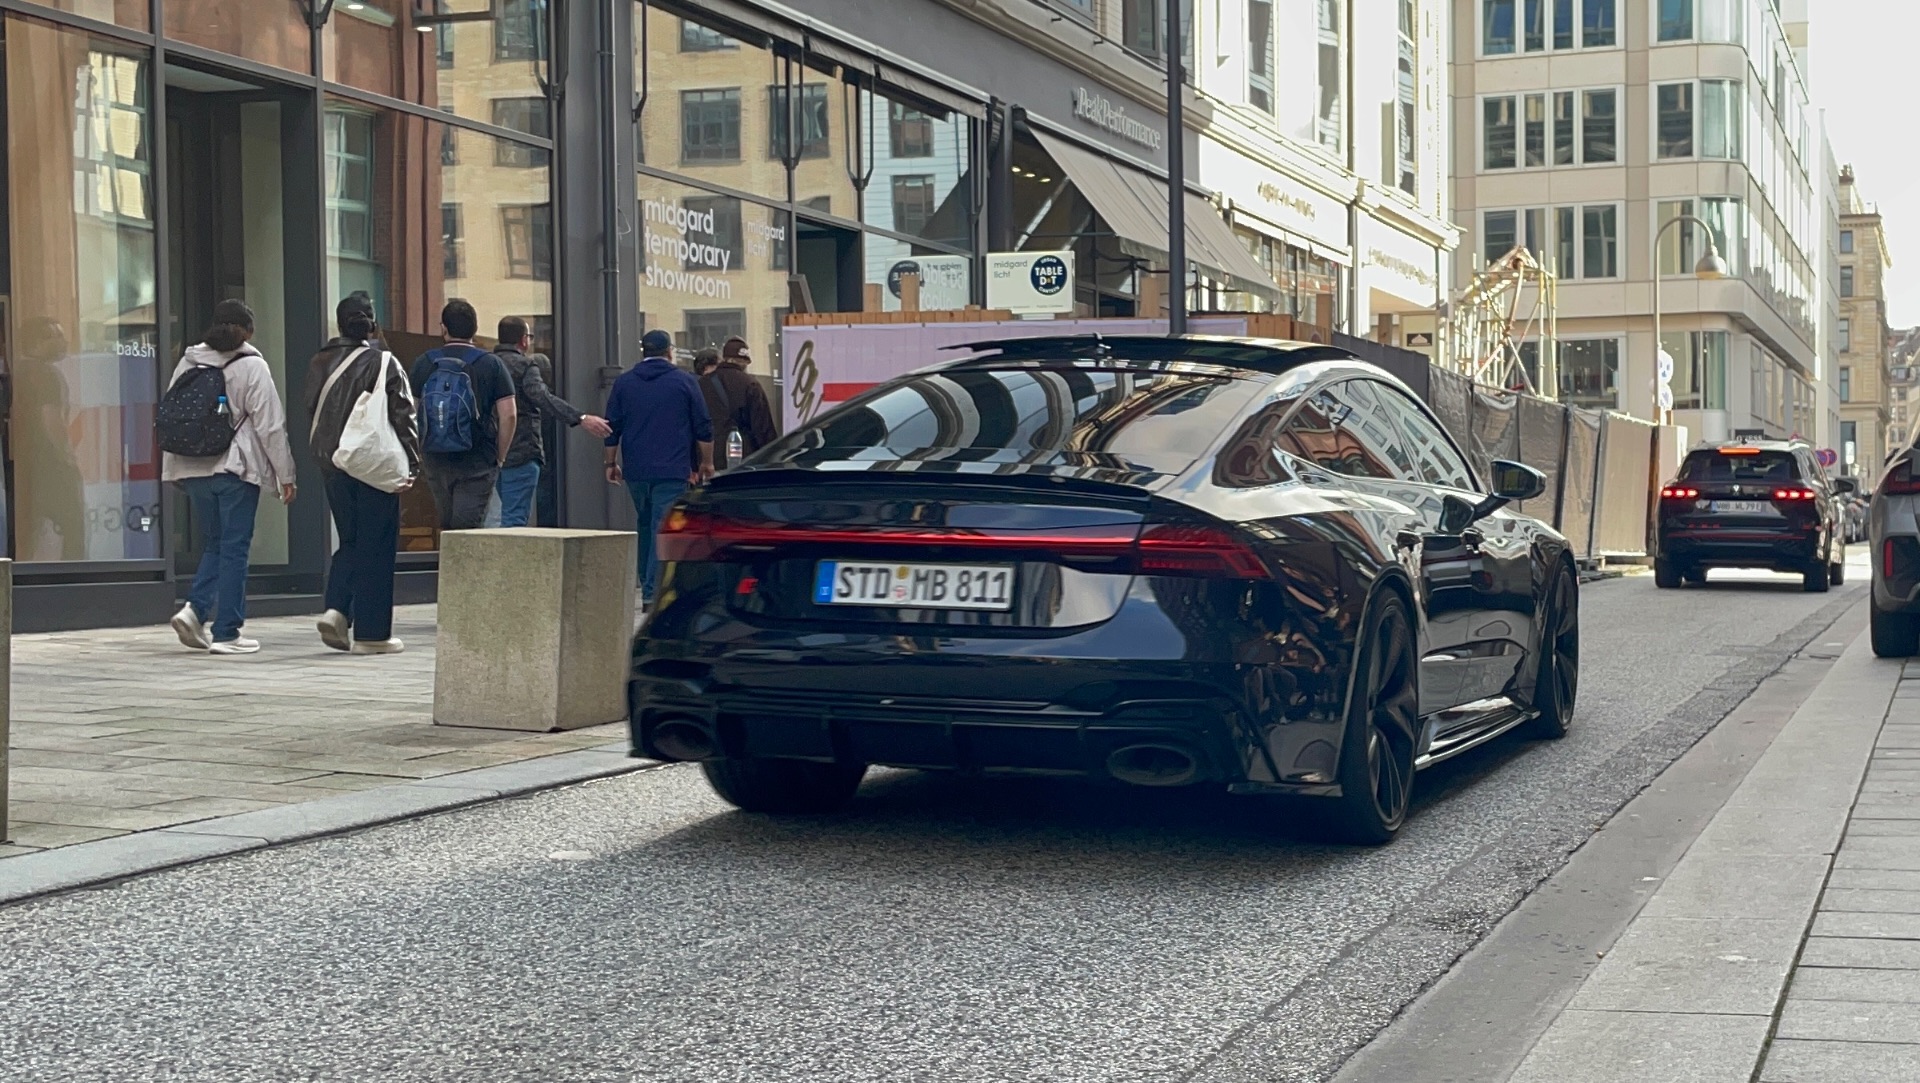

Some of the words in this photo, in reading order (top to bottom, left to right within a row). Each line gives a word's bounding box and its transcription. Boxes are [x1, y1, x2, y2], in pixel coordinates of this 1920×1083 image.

[644, 197, 714, 235] midgard
[747, 220, 785, 242] midgard
[644, 227, 731, 274] temporary
[993, 260, 1028, 270] midgard
[993, 271, 1011, 279] licht
[1034, 266, 1063, 276] TABLE
[645, 260, 731, 299] showroom
[116, 341, 156, 358] ba&sh
[836, 566, 891, 600] STD
[911, 568, 948, 602] MB
[956, 570, 1009, 604] 811
